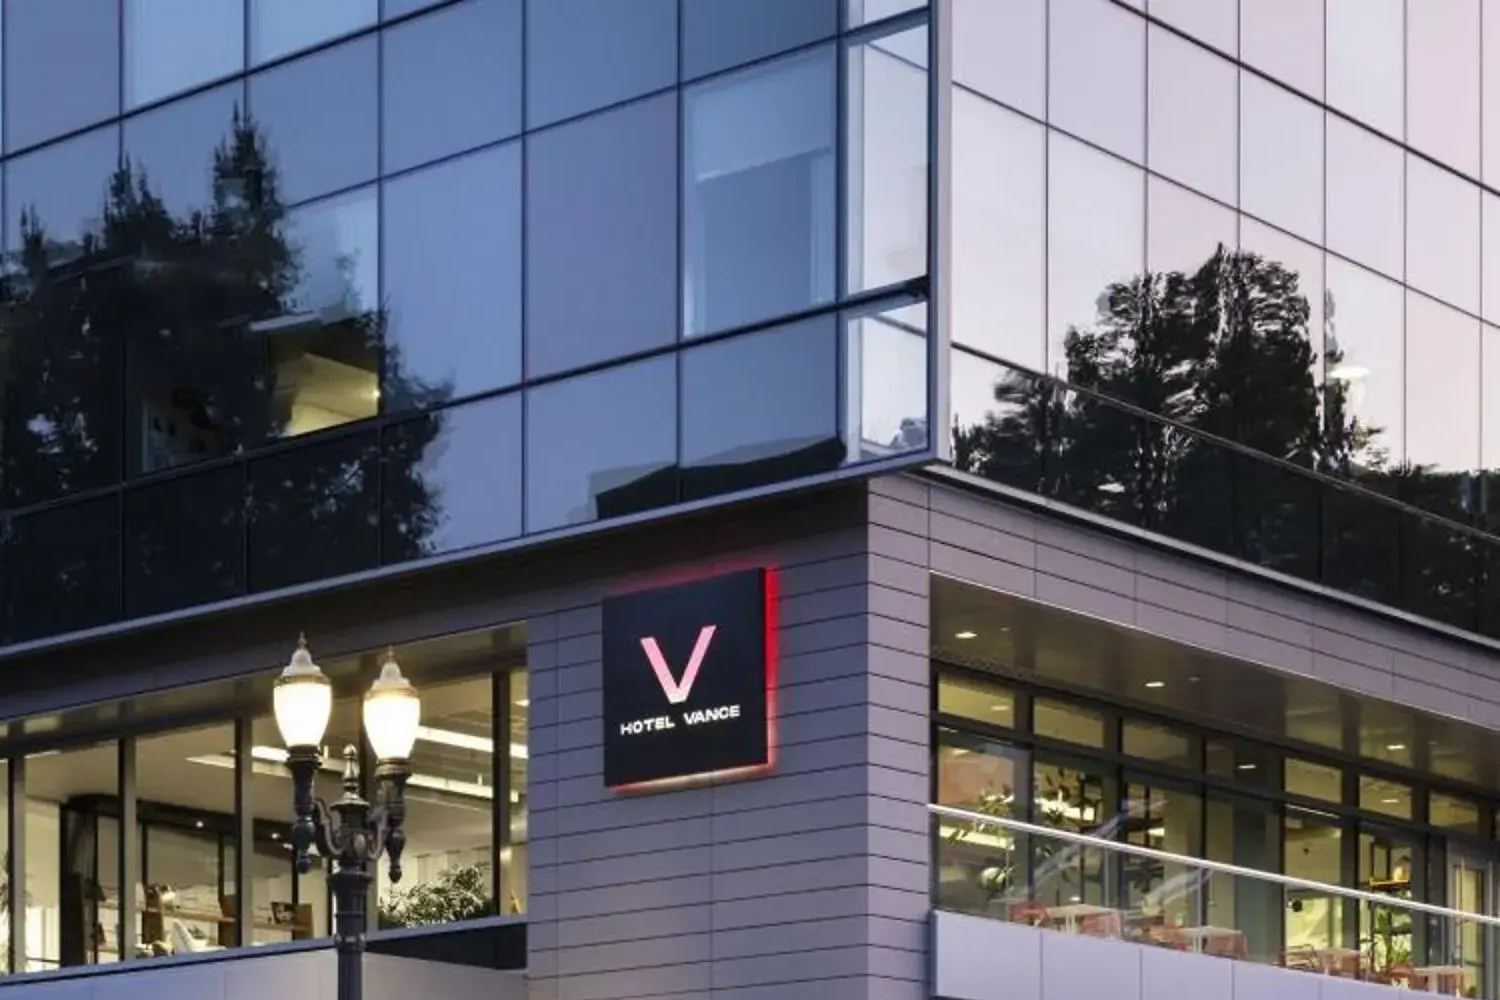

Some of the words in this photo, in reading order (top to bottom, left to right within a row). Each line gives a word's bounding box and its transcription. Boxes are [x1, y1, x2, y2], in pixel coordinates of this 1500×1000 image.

[640, 625, 717, 704] V
[620, 716, 675, 735] HOTEL
[683, 704, 740, 725] VANCE
